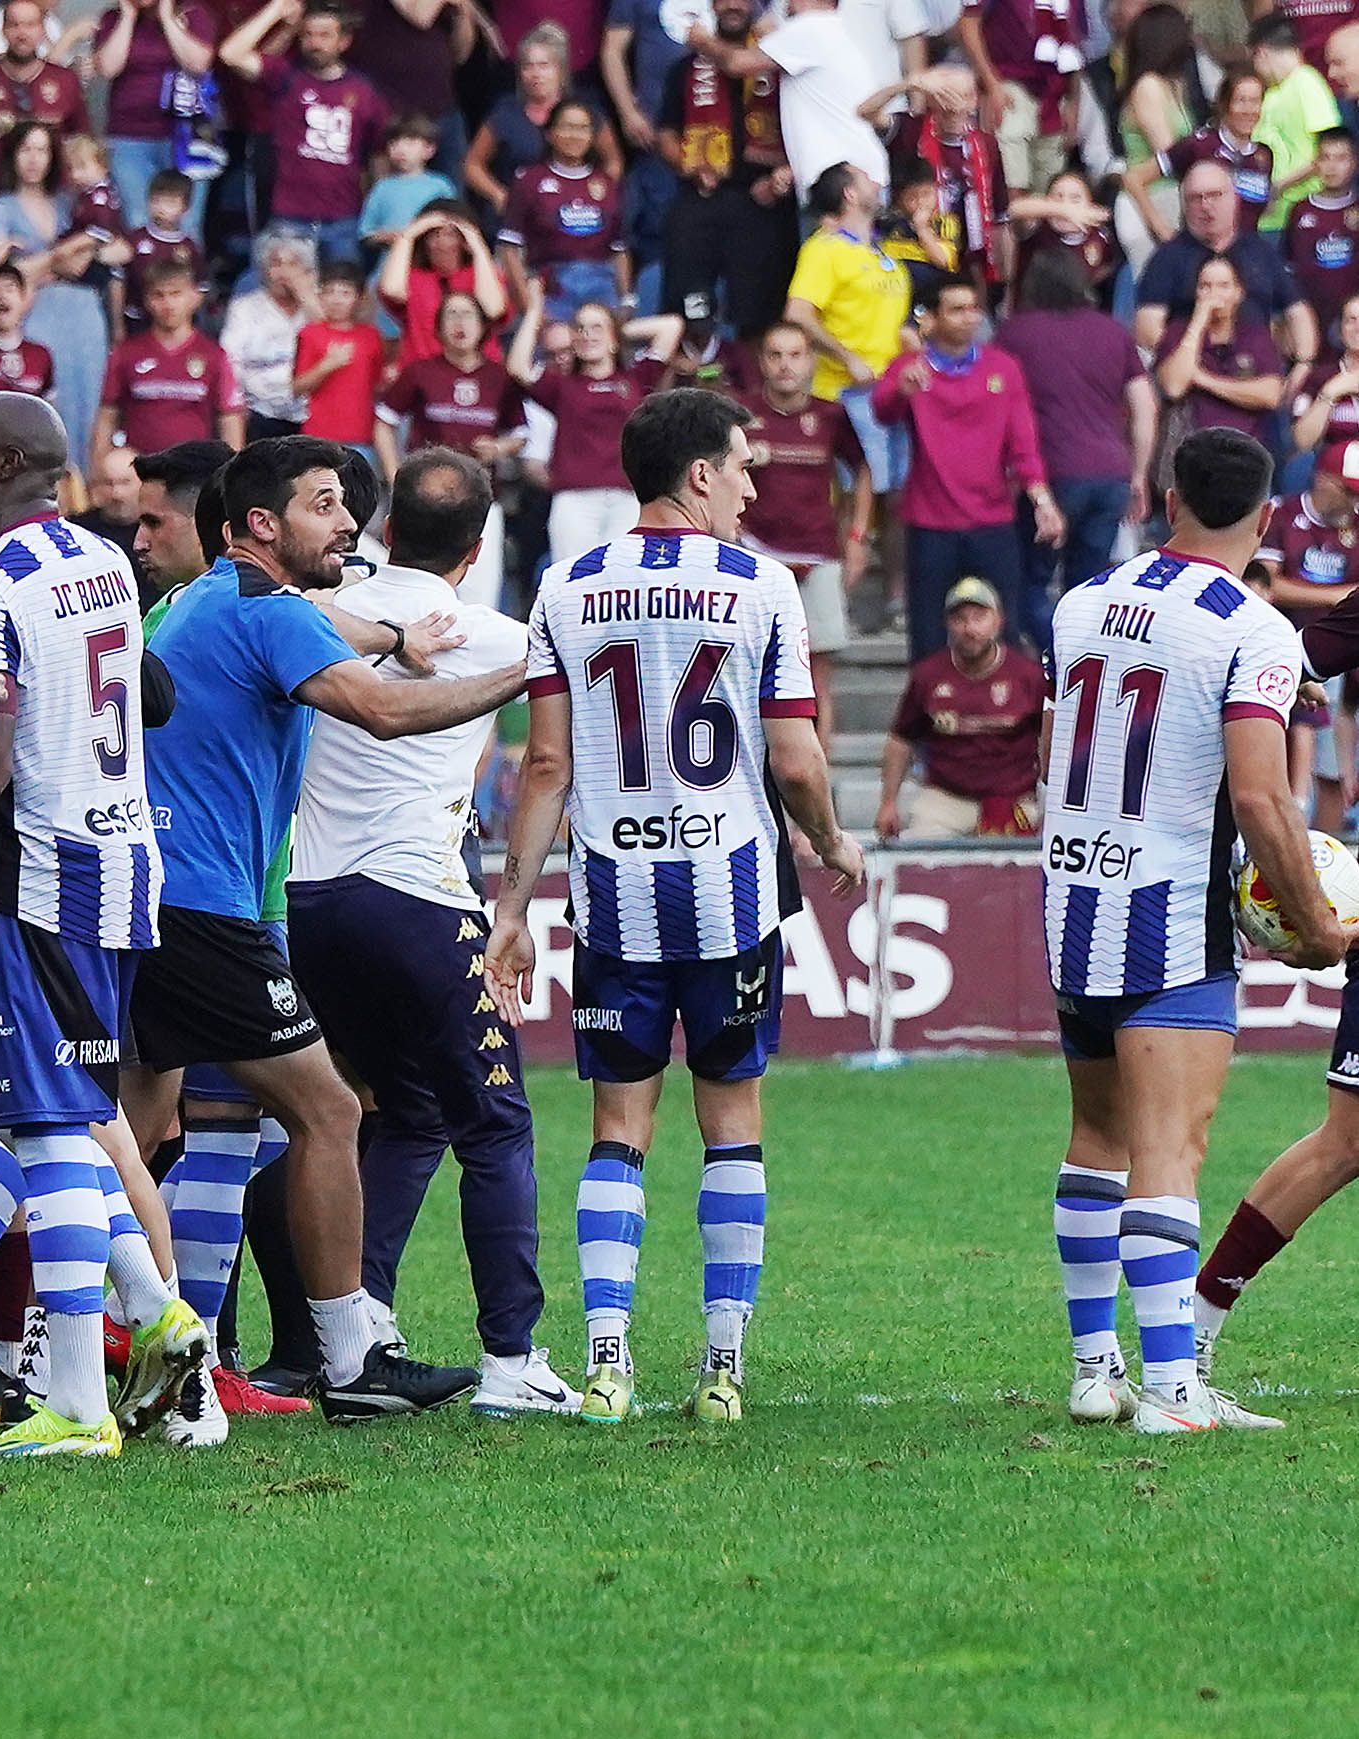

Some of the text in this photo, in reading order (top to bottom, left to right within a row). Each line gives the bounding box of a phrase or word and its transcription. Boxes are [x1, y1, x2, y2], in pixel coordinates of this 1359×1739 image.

[51, 570, 132, 619] JC BABIN
[581, 583, 738, 625] ADRI GÓMEZ
[1100, 603, 1156, 644] RAÚL
[83, 621, 129, 781] 5
[584, 638, 739, 792] 16
[1062, 652, 1169, 821] 11
[612, 804, 727, 850] esfer
[1049, 830, 1143, 880] esfer
